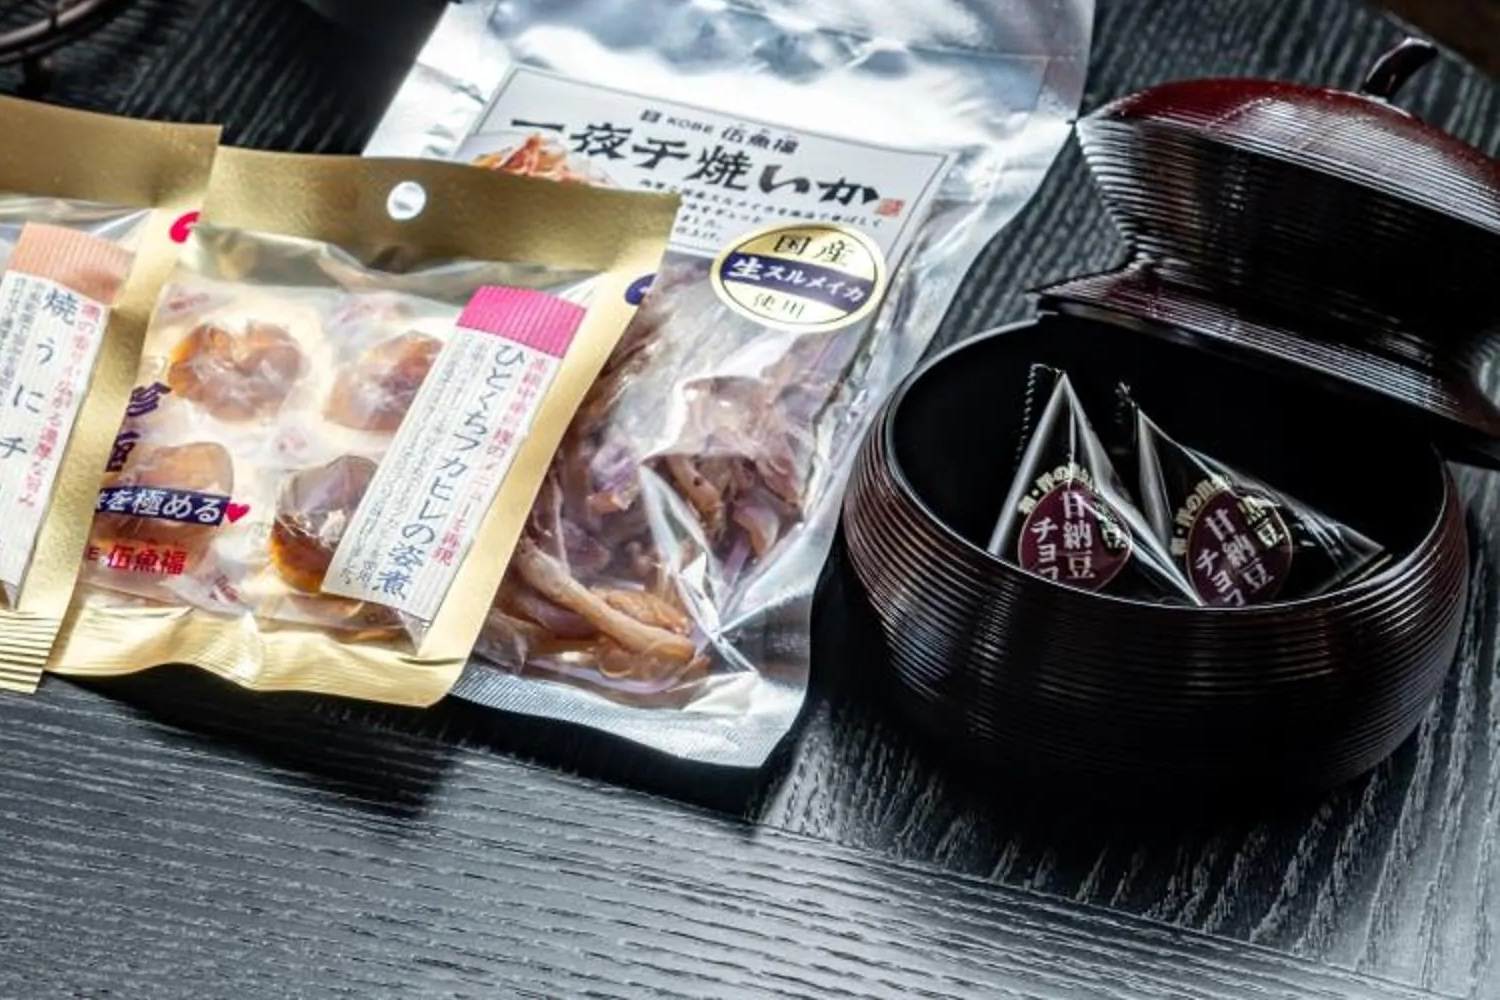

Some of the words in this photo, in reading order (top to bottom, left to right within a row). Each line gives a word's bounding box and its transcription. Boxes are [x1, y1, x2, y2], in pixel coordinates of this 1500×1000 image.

[666, 115, 714, 135] KOBE
[510, 118, 880, 207] 一夜干焼いか
[729, 256, 867, 303] 生スルメイカ
[773, 232, 855, 268] 国産
[375, 344, 526, 601] ひとくちフカヒレの姿煮
[1205, 508, 1275, 590] 甘納豆
